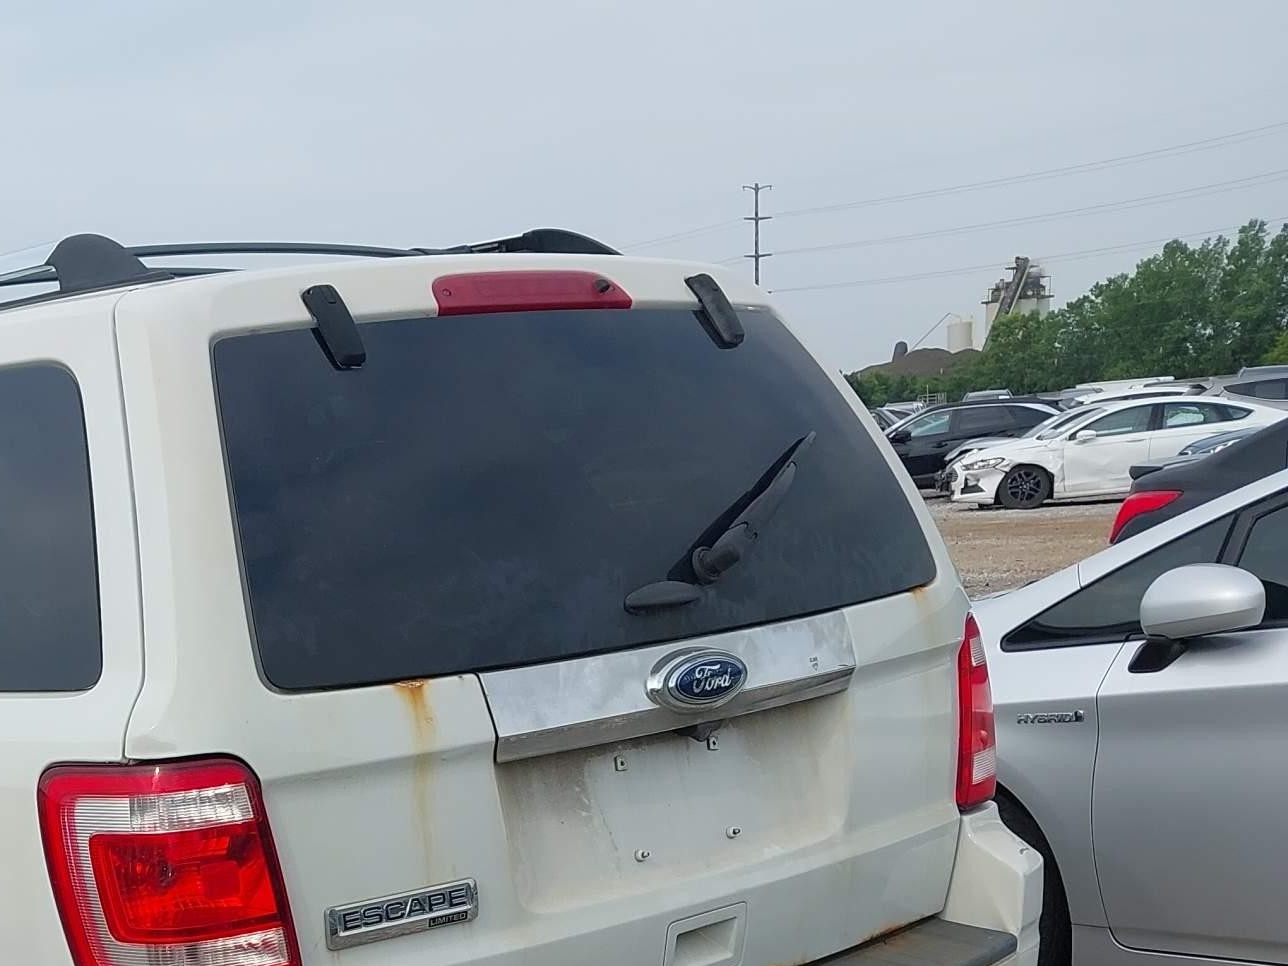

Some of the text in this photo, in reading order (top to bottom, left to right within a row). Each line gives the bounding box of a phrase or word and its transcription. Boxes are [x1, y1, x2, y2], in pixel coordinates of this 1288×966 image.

[692, 664, 733, 693] Ford
[1016, 711, 1073, 725] HYBRID
[342, 887, 468, 932] ESCAPE
[429, 911, 468, 927] LIMITED
